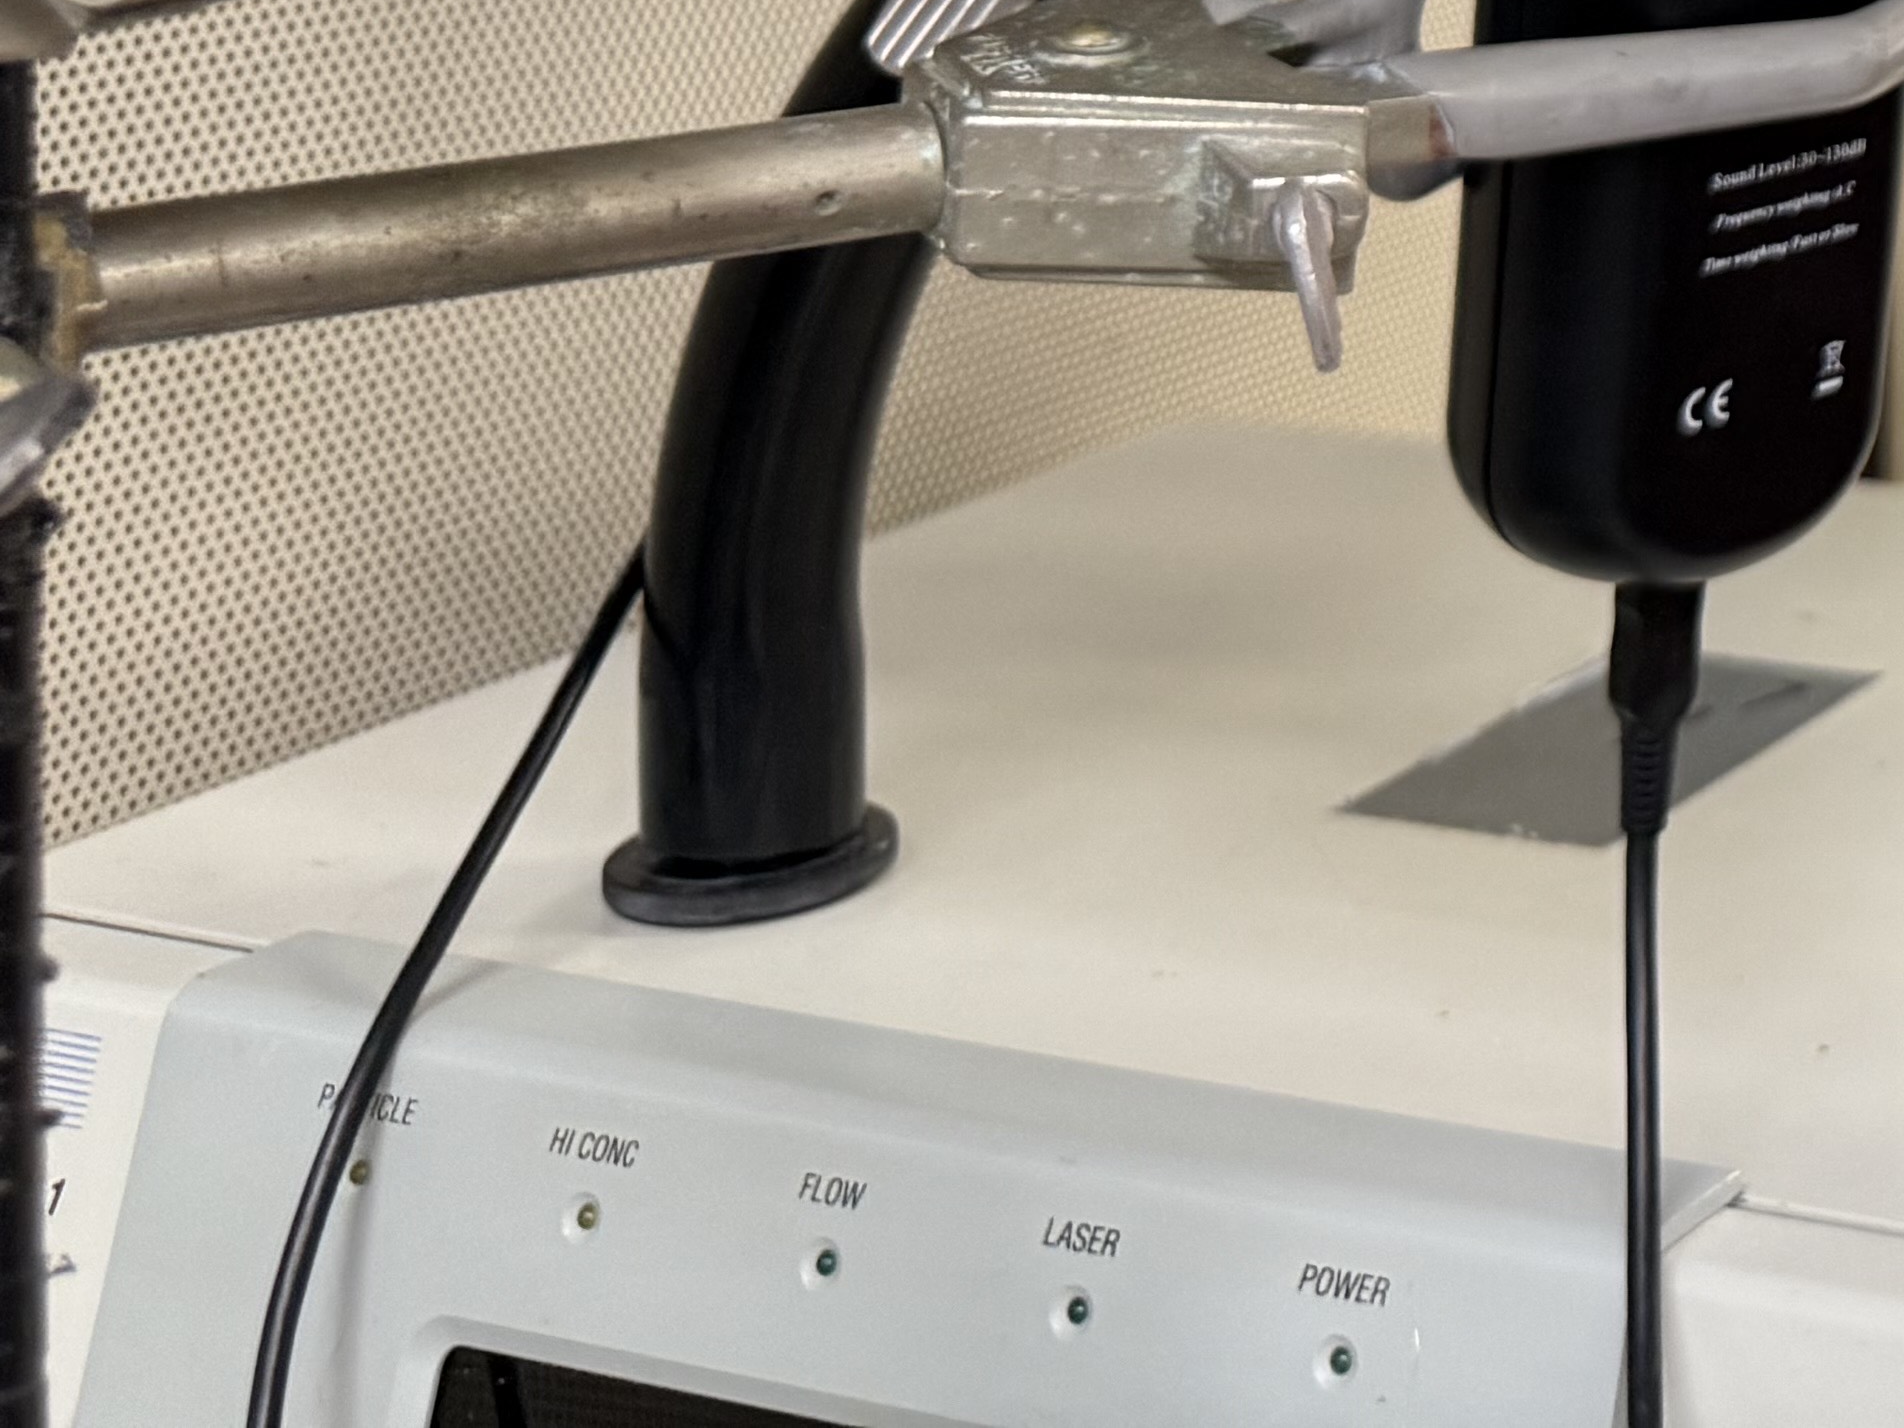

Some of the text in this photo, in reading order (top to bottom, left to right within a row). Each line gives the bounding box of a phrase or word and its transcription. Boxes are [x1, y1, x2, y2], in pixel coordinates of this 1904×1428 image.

[1710, 163, 1757, 192] Sound
[1678, 377, 1734, 436] CE
[317, 1082, 419, 1126] PICLE
[549, 1126, 640, 1169] HI CONC
[799, 1172, 868, 1211] FLOW
[1043, 1216, 1121, 1258] LASER
[1299, 1263, 1390, 1307] POWER
